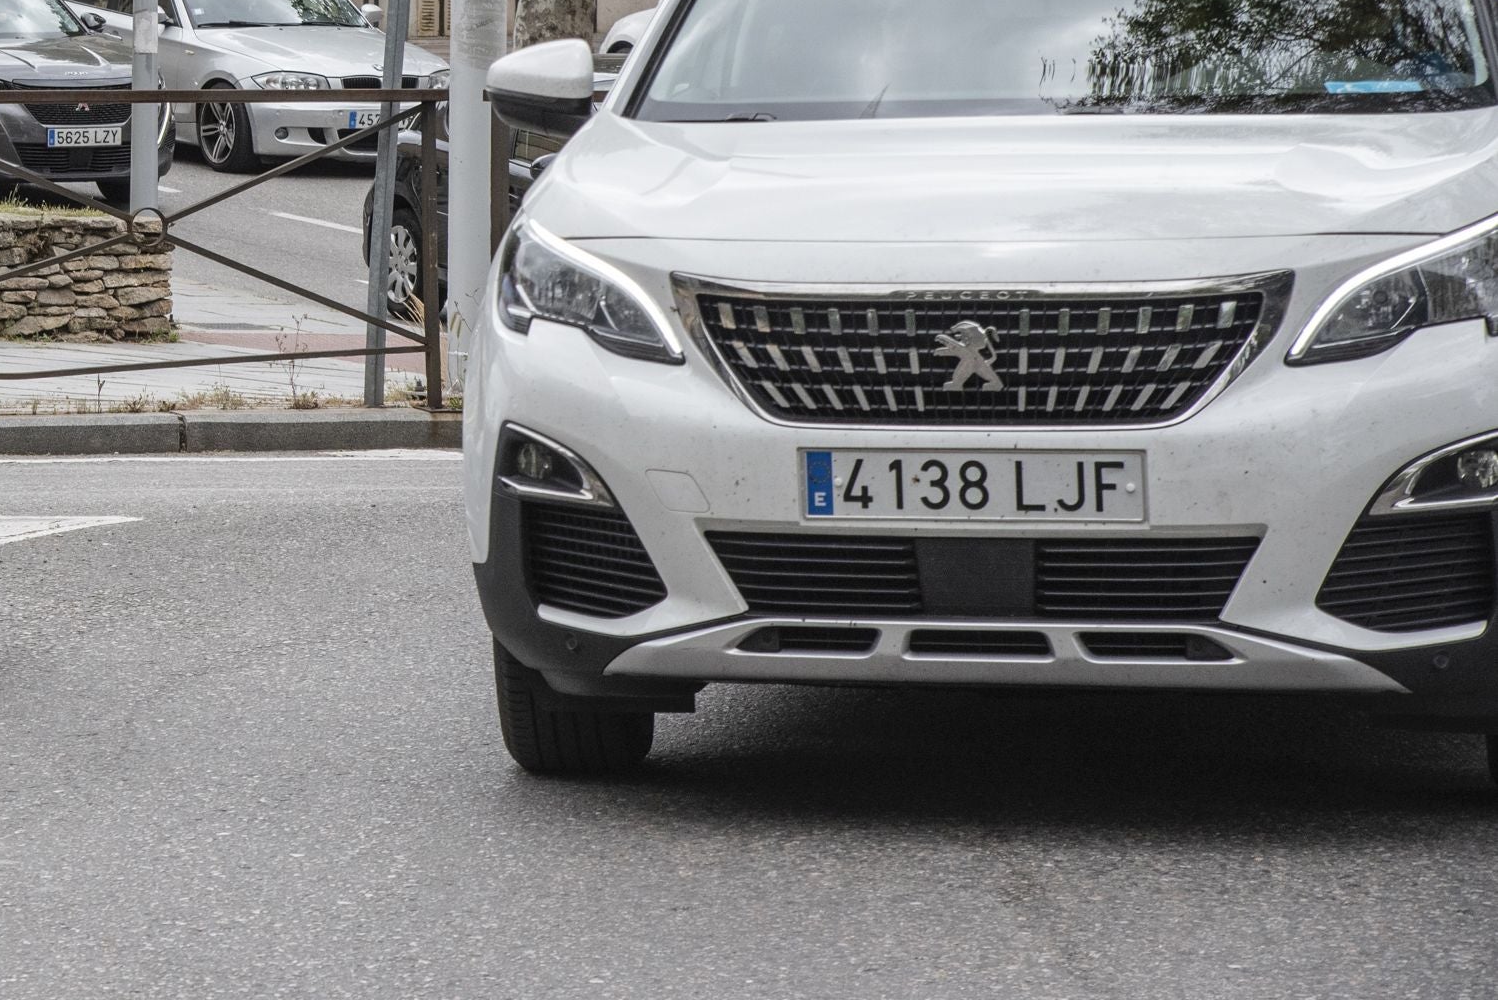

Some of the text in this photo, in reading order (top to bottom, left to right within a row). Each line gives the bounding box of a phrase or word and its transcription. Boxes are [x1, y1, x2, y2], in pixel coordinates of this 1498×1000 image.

[358, 113, 381, 126] 457
[57, 129, 118, 145] 5625 LZY
[907, 290, 1028, 300] PEUGEOT
[813, 458, 1125, 513] E 4138 LJF
